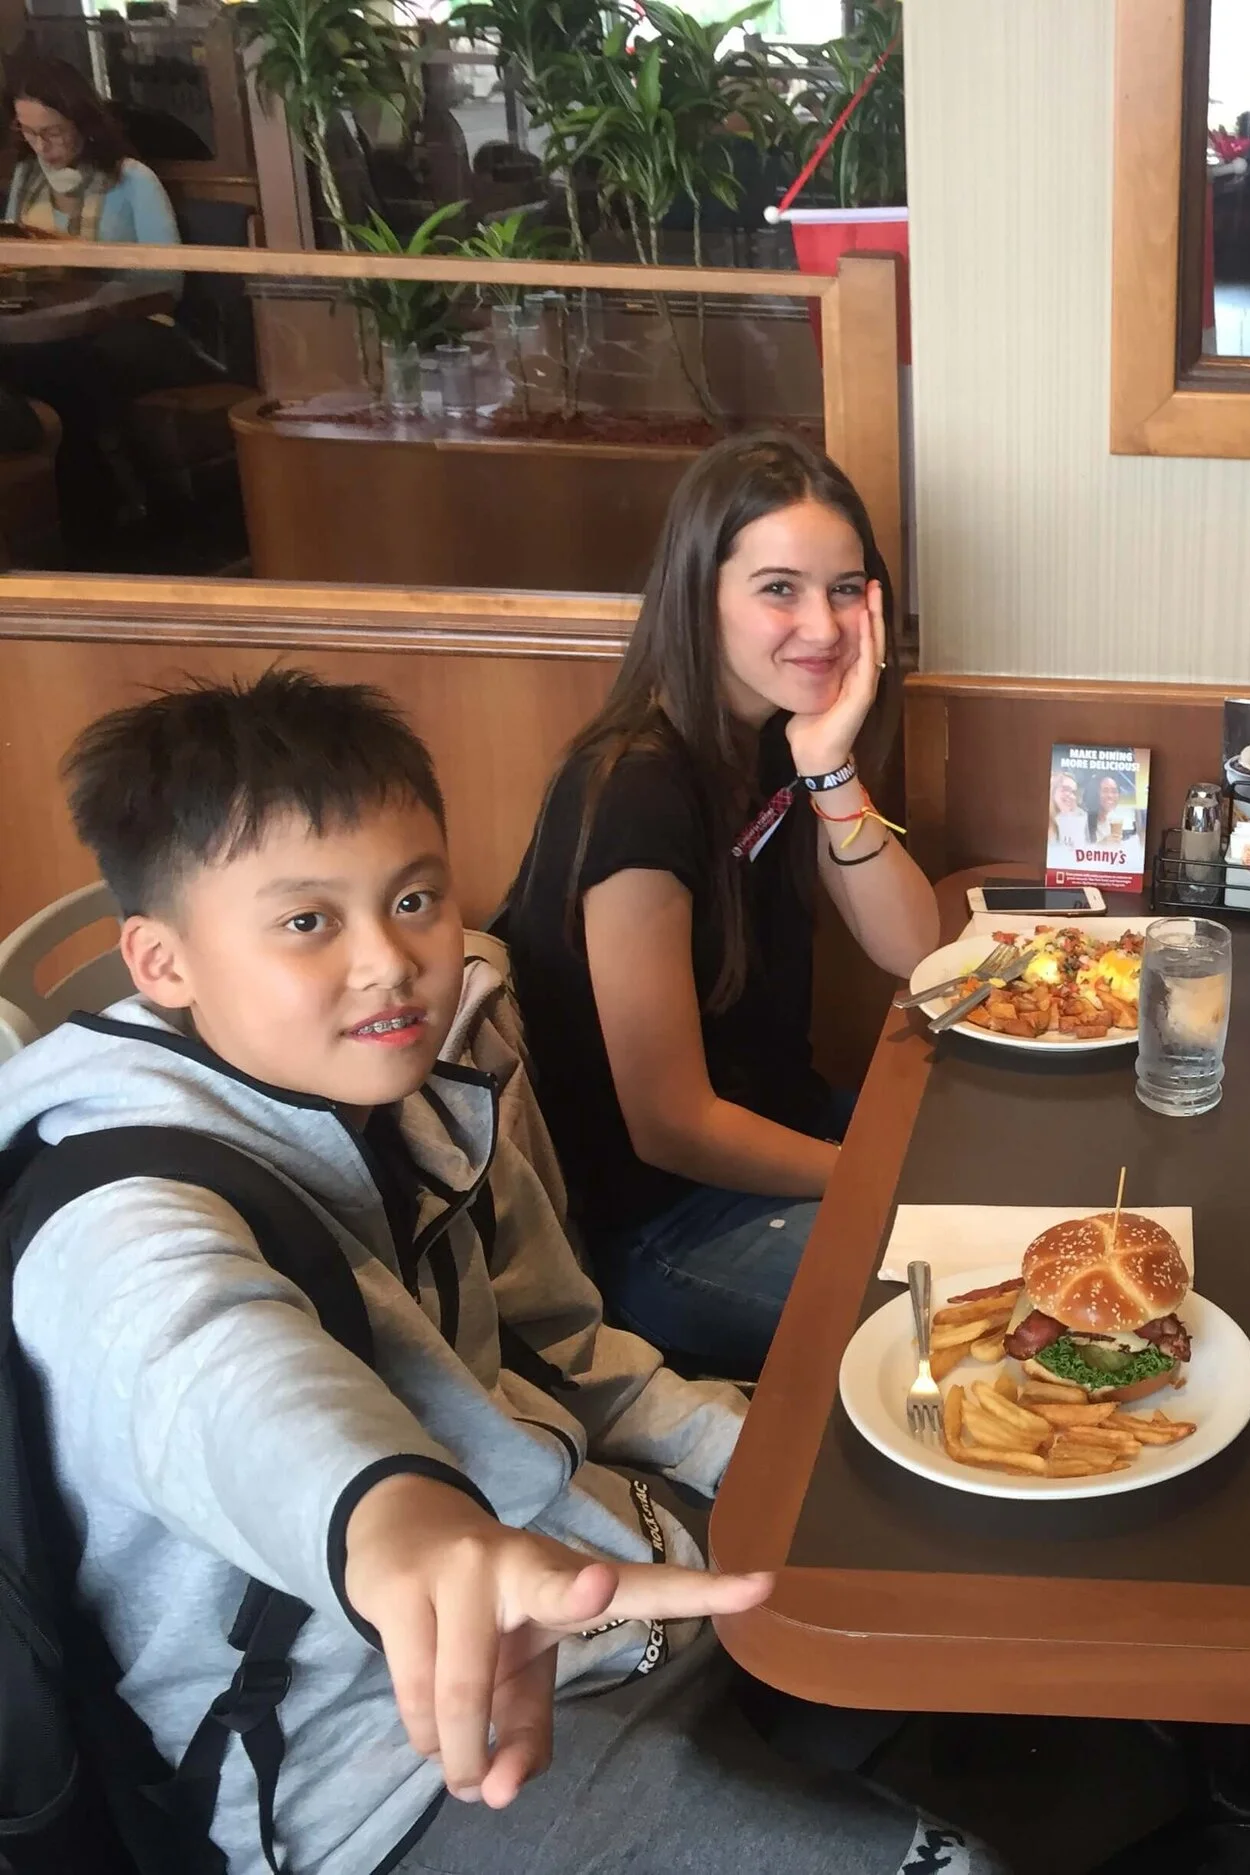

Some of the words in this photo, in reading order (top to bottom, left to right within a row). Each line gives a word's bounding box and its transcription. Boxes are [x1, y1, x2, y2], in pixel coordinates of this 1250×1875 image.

[1069, 748, 1098, 759] MAKE
[1099, 750, 1133, 762] DINING
[1061, 758, 1089, 768] MORE
[1075, 848, 1127, 865] Denny's
